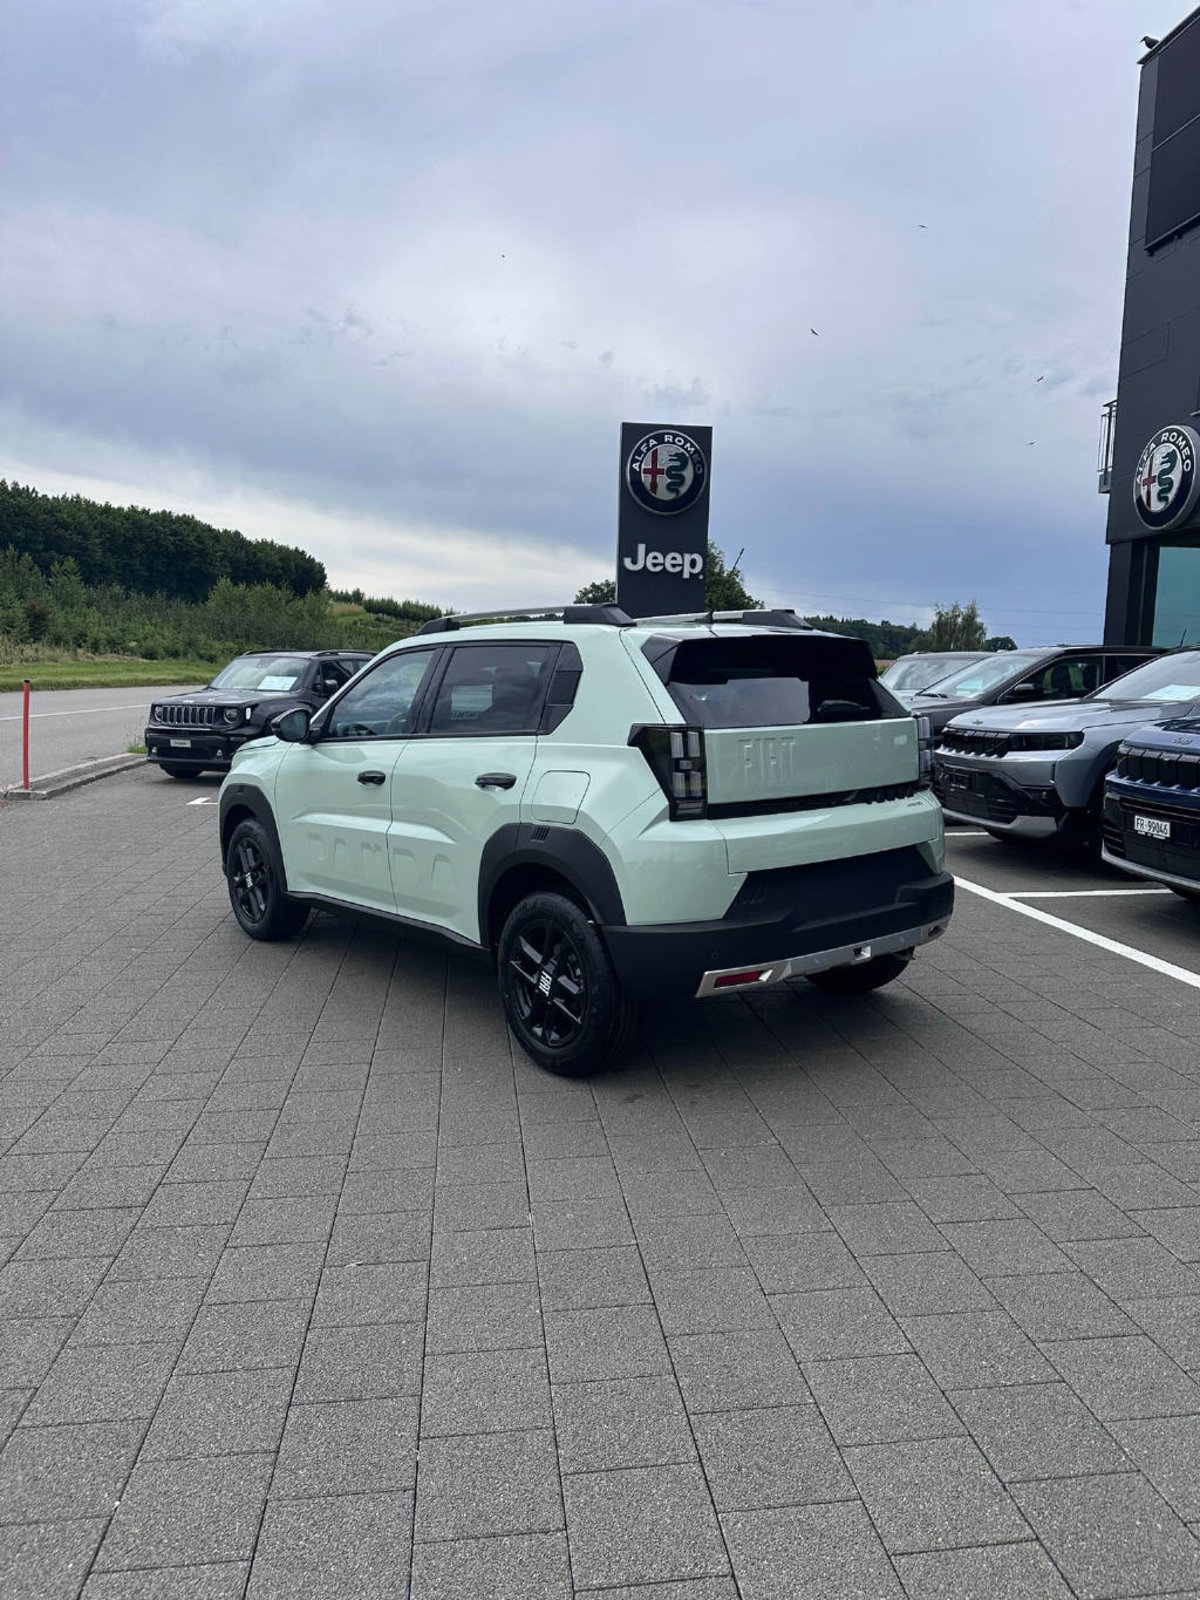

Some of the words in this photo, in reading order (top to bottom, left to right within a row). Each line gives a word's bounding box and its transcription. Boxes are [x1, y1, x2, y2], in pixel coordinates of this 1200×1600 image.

[632, 437, 659, 472] ALFA
[663, 434, 703, 475] ROMEO
[1160, 431, 1192, 472] ROMEO
[538, 970, 553, 997] FIAT
